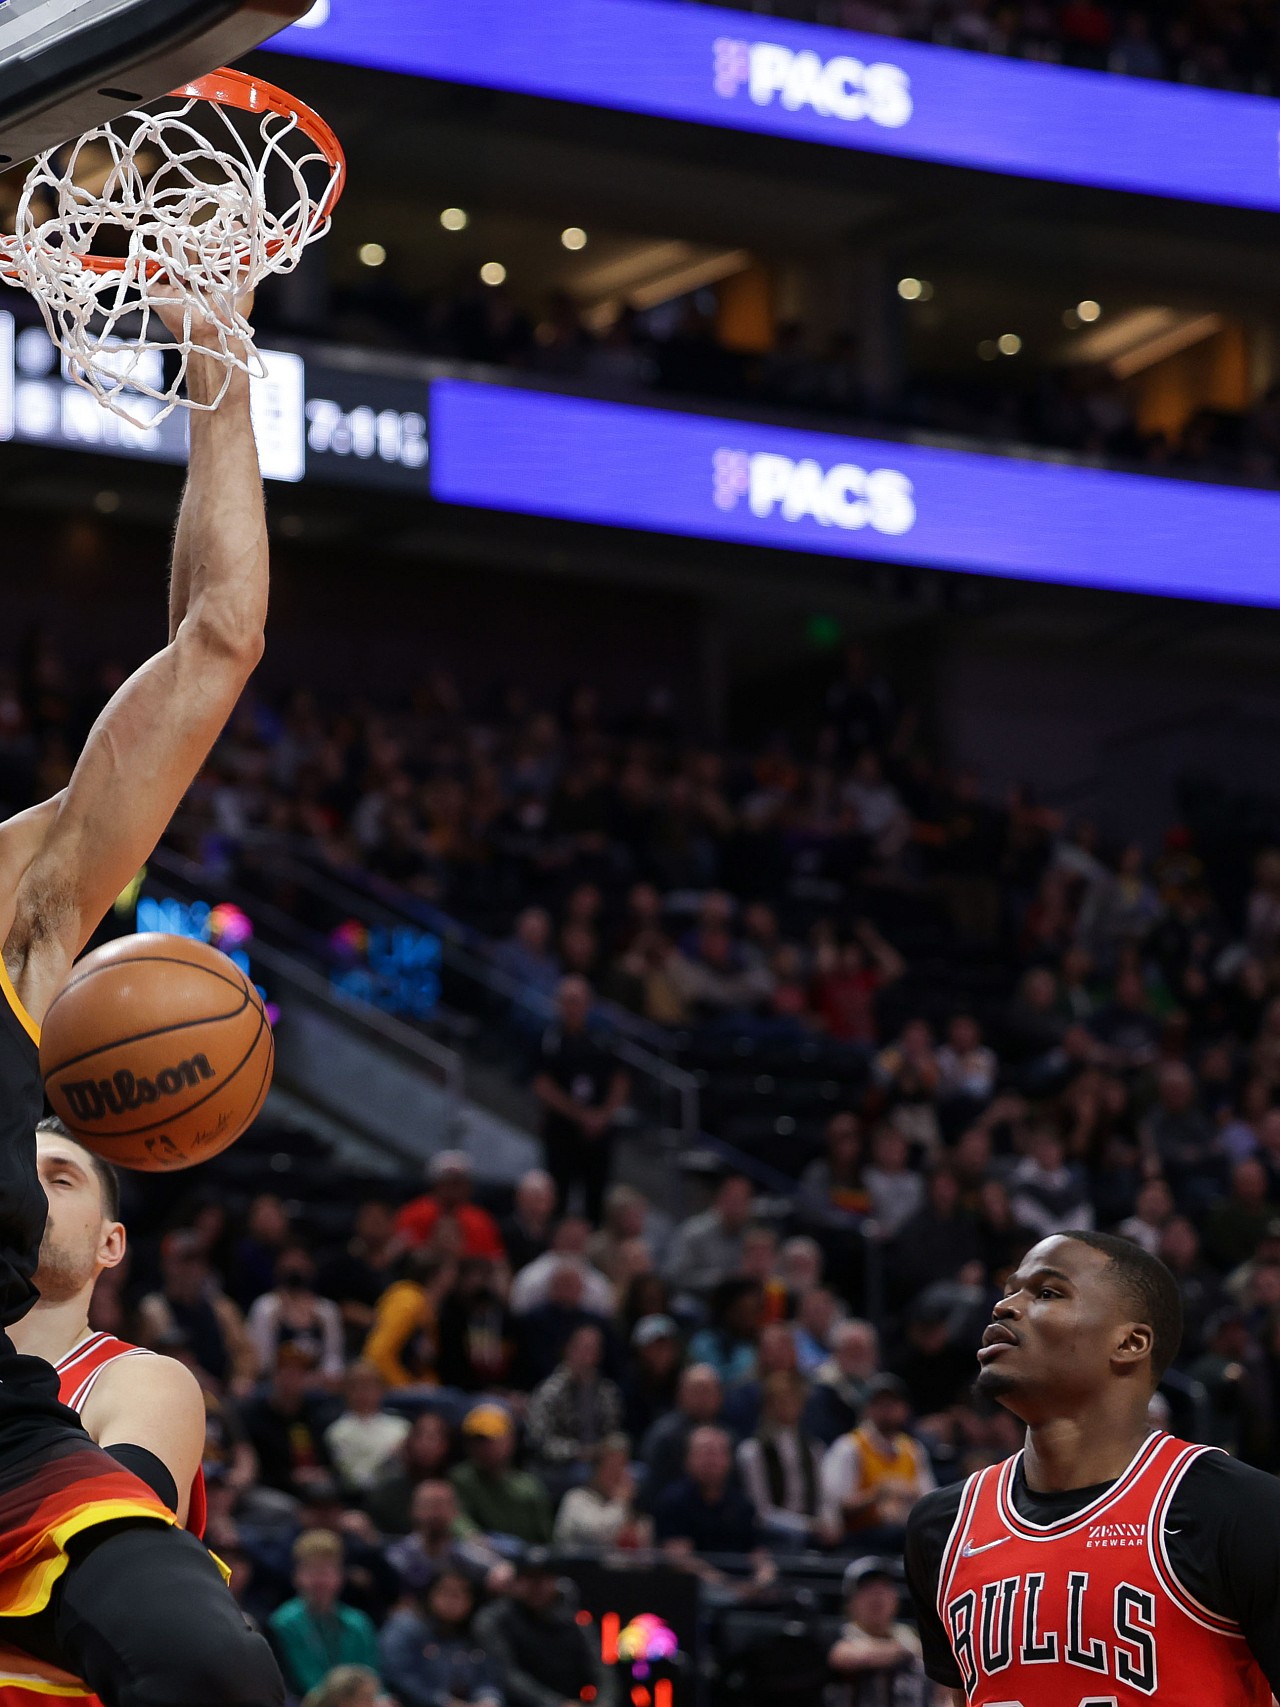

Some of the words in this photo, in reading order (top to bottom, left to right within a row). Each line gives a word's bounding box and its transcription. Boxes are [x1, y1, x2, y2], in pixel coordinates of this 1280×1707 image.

[748, 41, 914, 129] PACS
[748, 451, 917, 537] PACS
[60, 1053, 216, 1121] Wilson
[1086, 1538, 1144, 1548] EYEWEAR
[948, 1570, 1158, 1700] BULLS
